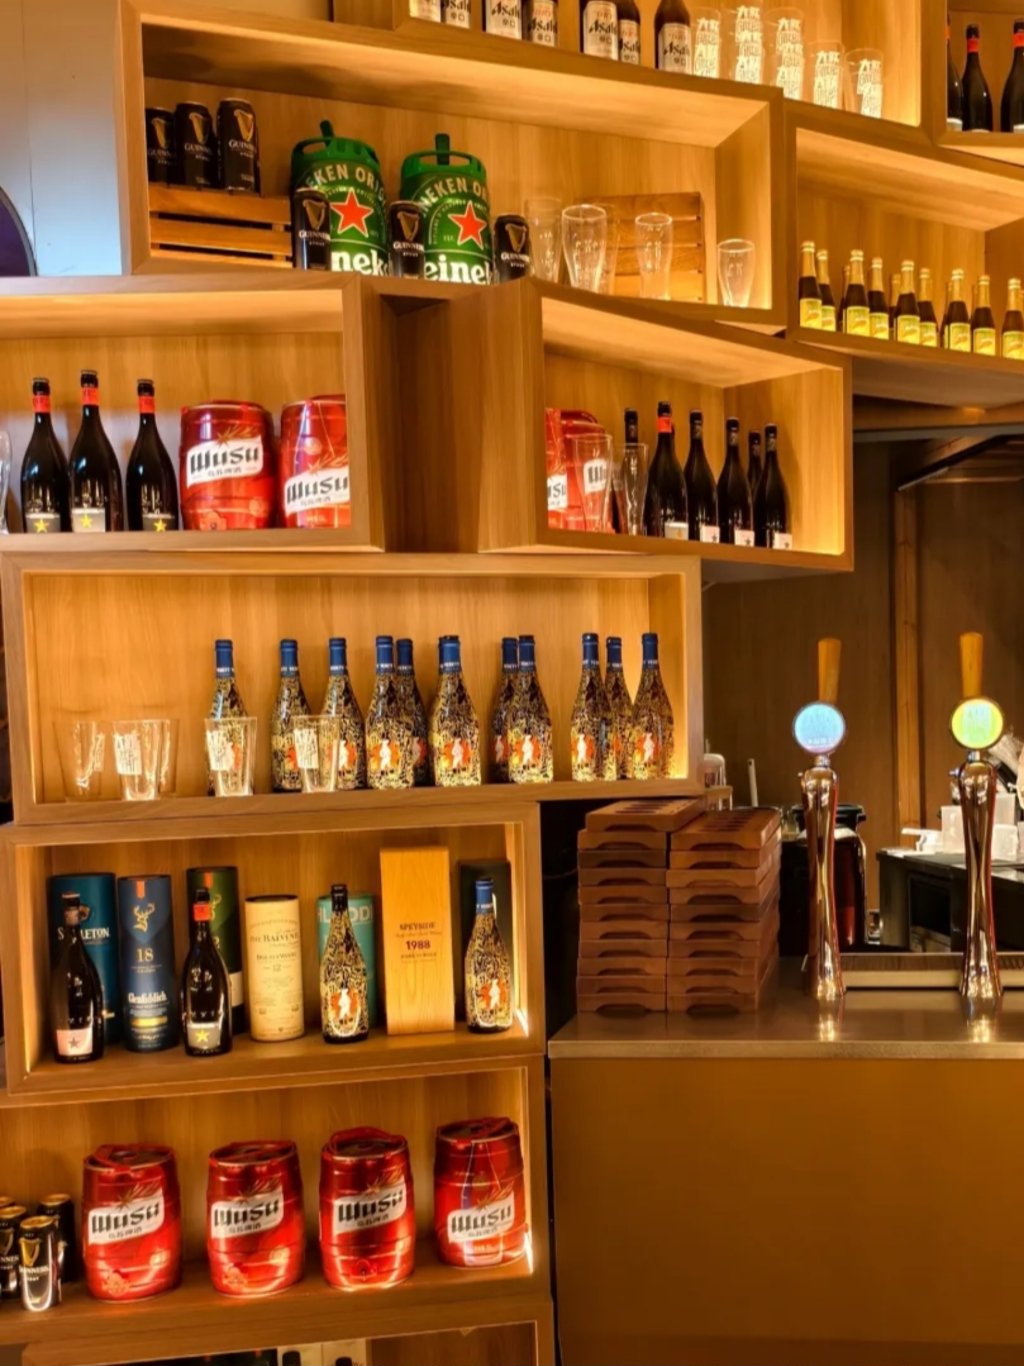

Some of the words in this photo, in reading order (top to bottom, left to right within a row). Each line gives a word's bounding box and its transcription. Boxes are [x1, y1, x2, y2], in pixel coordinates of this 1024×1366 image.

[57, 927, 110, 941] SLETON
[406, 940, 431, 950] 1988
[137, 948, 154, 963] 18
